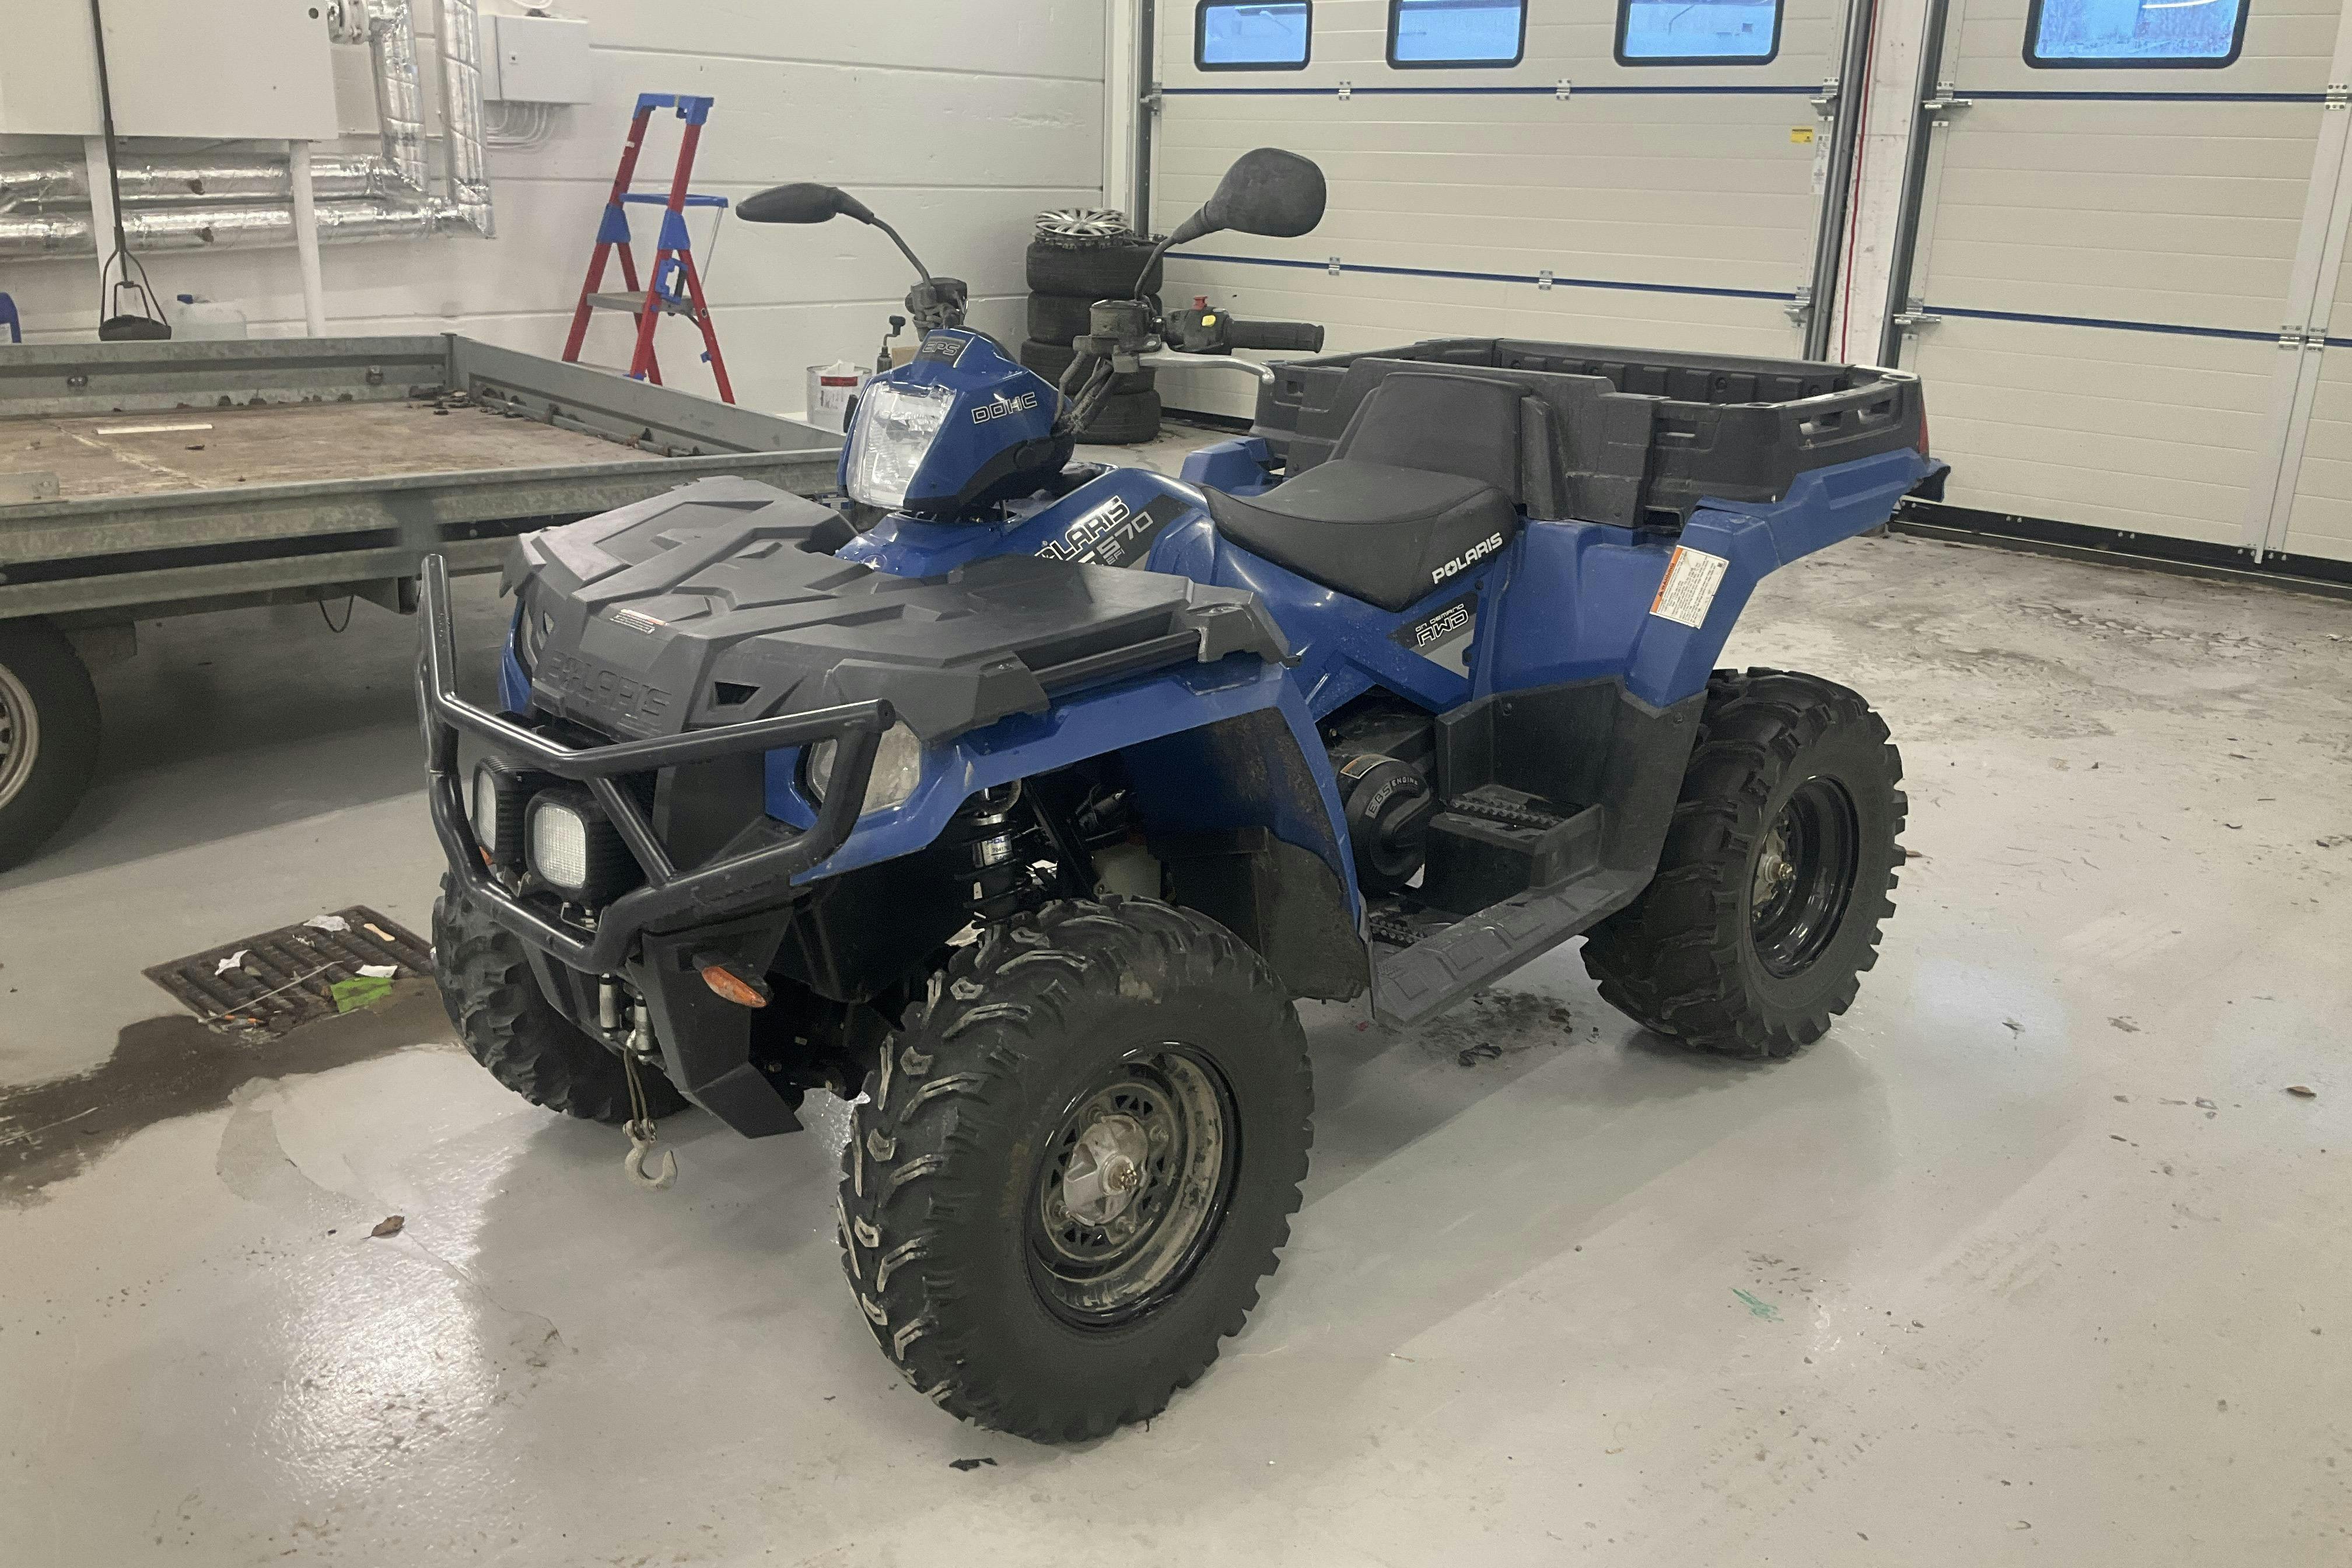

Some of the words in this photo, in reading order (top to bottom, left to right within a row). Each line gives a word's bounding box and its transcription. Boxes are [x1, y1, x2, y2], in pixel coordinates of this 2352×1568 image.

[922, 342, 961, 356] EPS
[971, 392, 1038, 424] DOHC
[1096, 512, 1154, 555] 570
[1432, 532, 1503, 584] POLARIS
[1416, 609, 1469, 648] AWD
[542, 649, 673, 718] POLARIS
[1368, 783, 1393, 814] EBS
